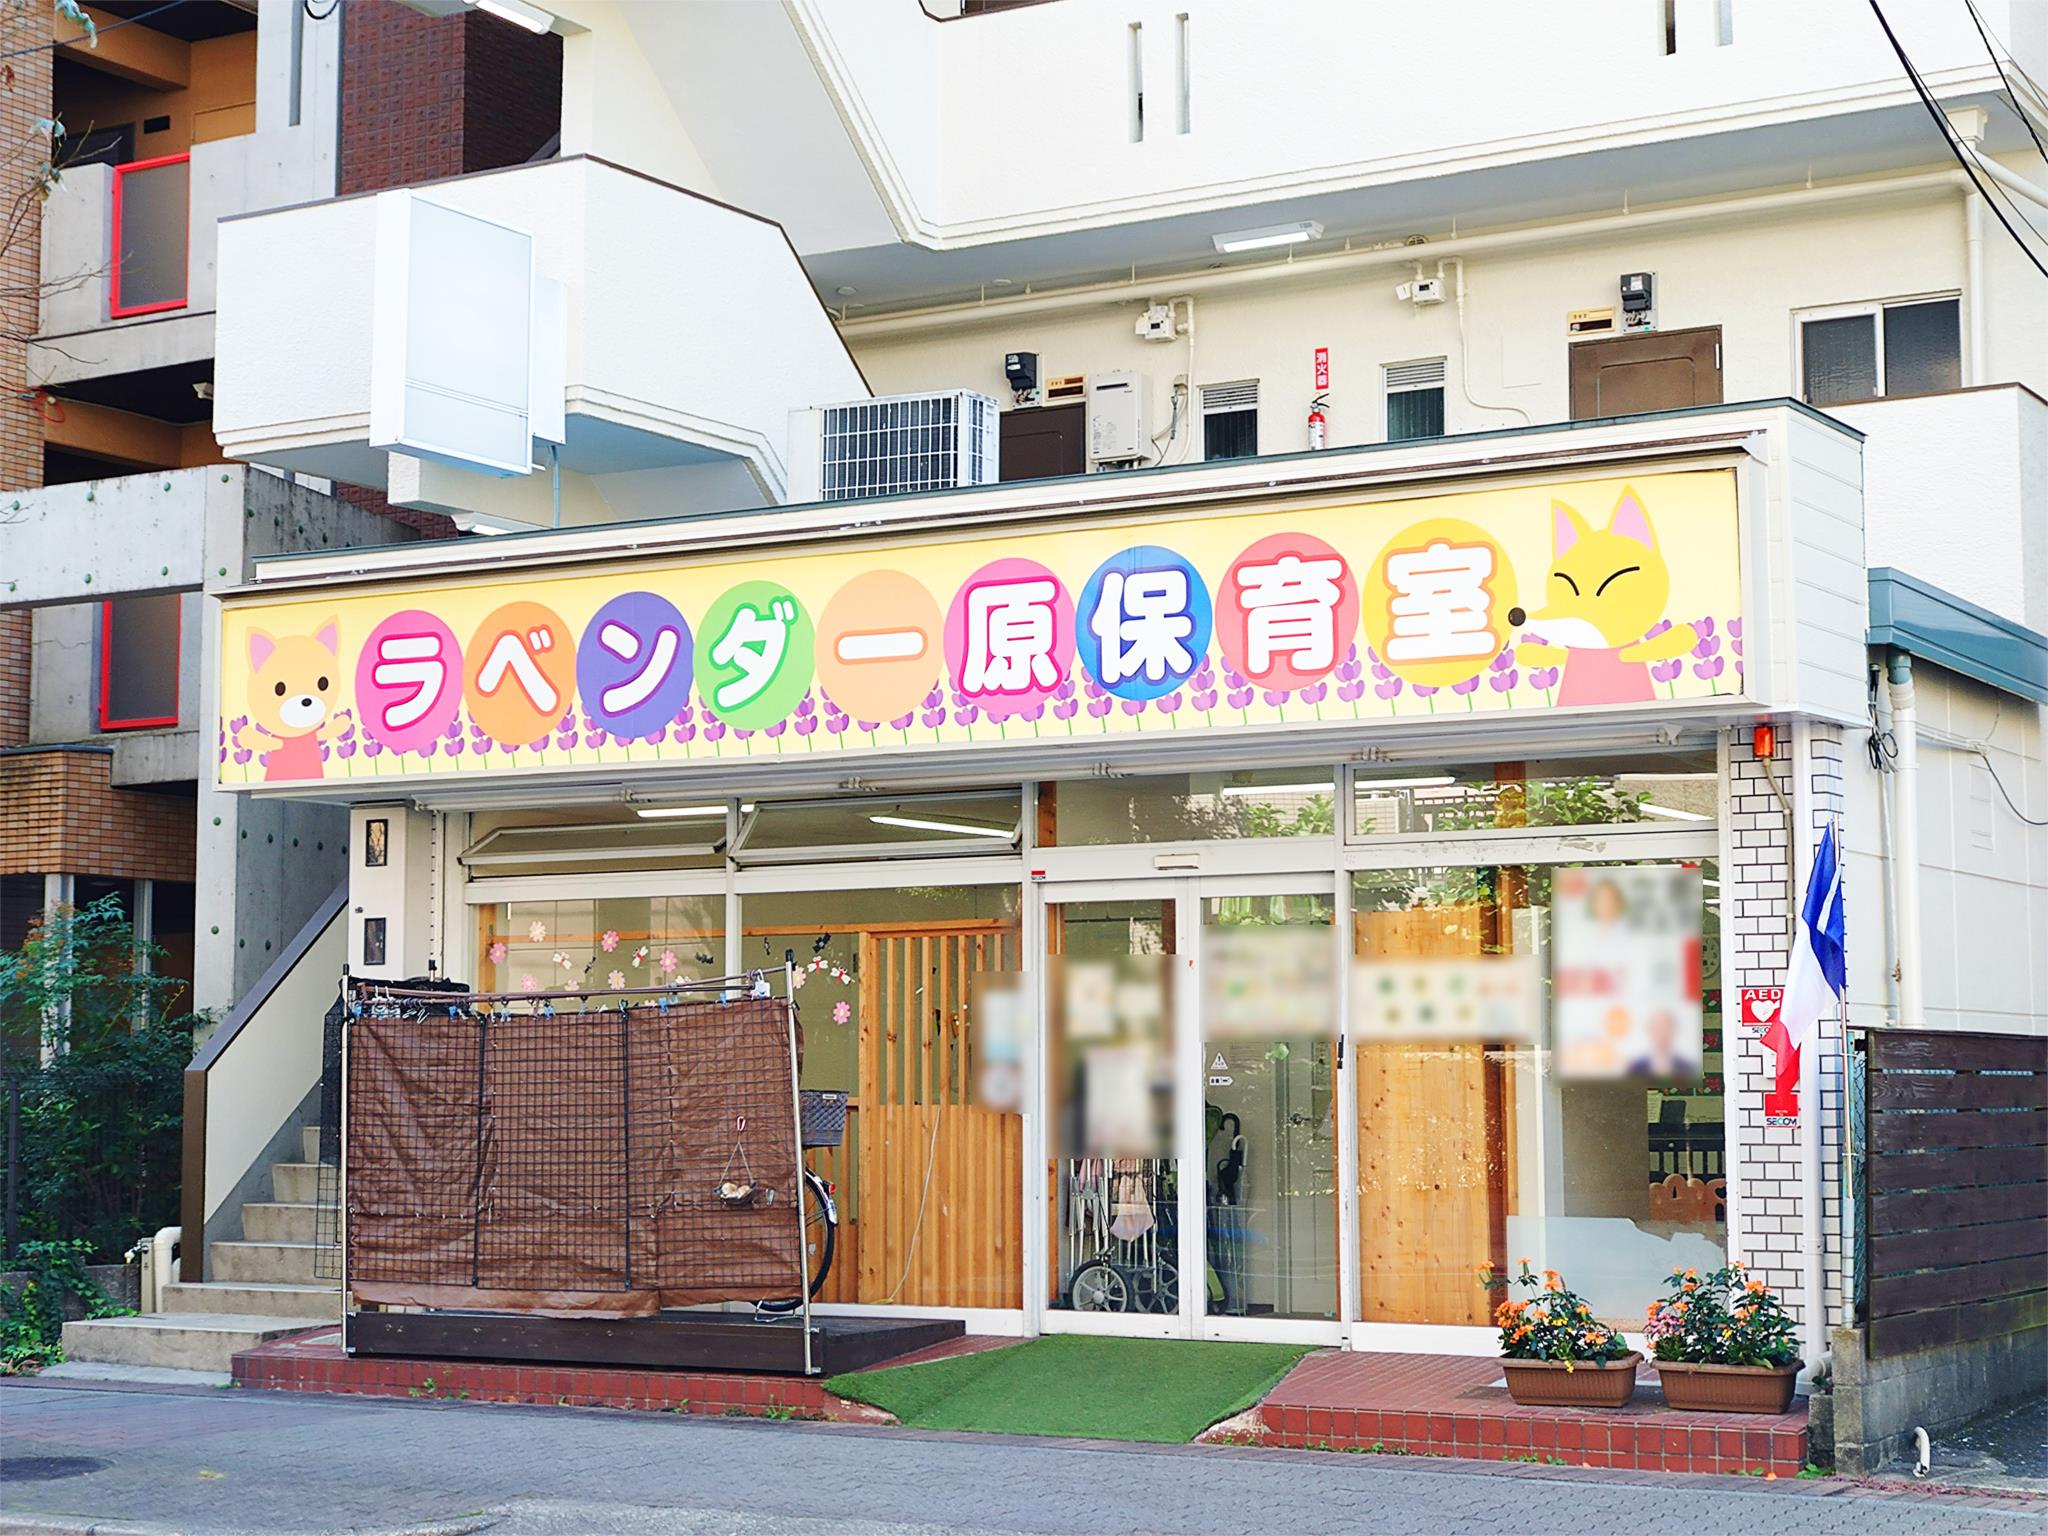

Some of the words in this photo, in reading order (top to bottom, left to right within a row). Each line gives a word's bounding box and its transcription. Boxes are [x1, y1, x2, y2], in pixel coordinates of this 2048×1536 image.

[372, 537, 1501, 732] ラベンダー原保育室
[1744, 989, 1782, 1000] AED
[1766, 1117, 1798, 1126] SECOM
